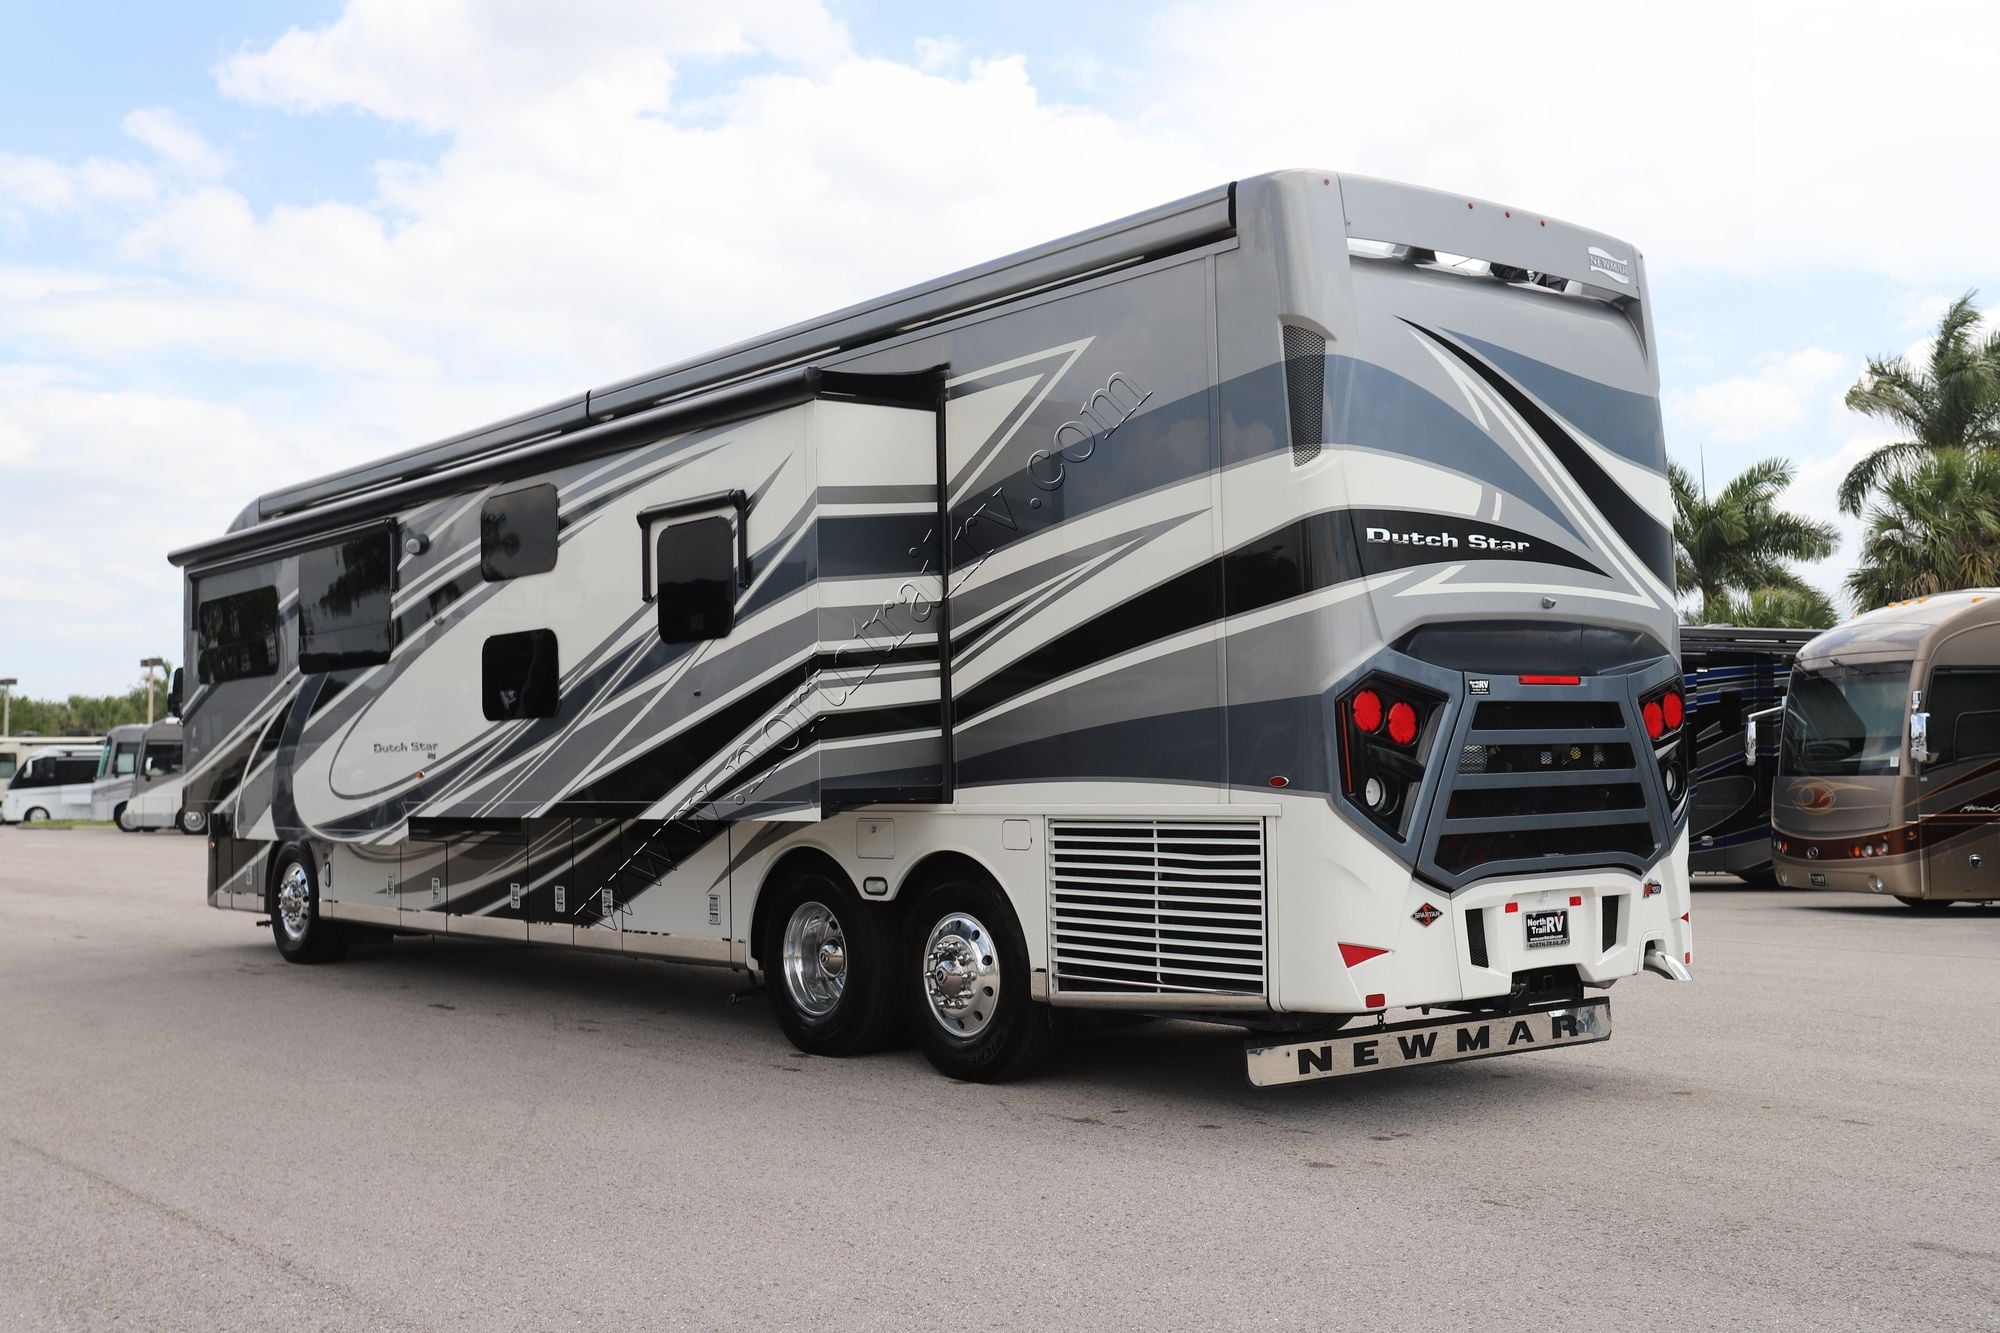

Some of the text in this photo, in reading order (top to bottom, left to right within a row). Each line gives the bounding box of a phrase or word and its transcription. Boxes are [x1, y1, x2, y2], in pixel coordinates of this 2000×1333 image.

[1366, 527, 1530, 553] Dutch Star
[373, 742, 438, 753] Dutch Star
[1414, 911, 1440, 919] SPARTAN
[1527, 917, 1546, 927] North
[1546, 916, 1564, 932] RV
[1531, 926, 1546, 934] Trail
[1297, 1013, 1579, 1075] NEWMAR
